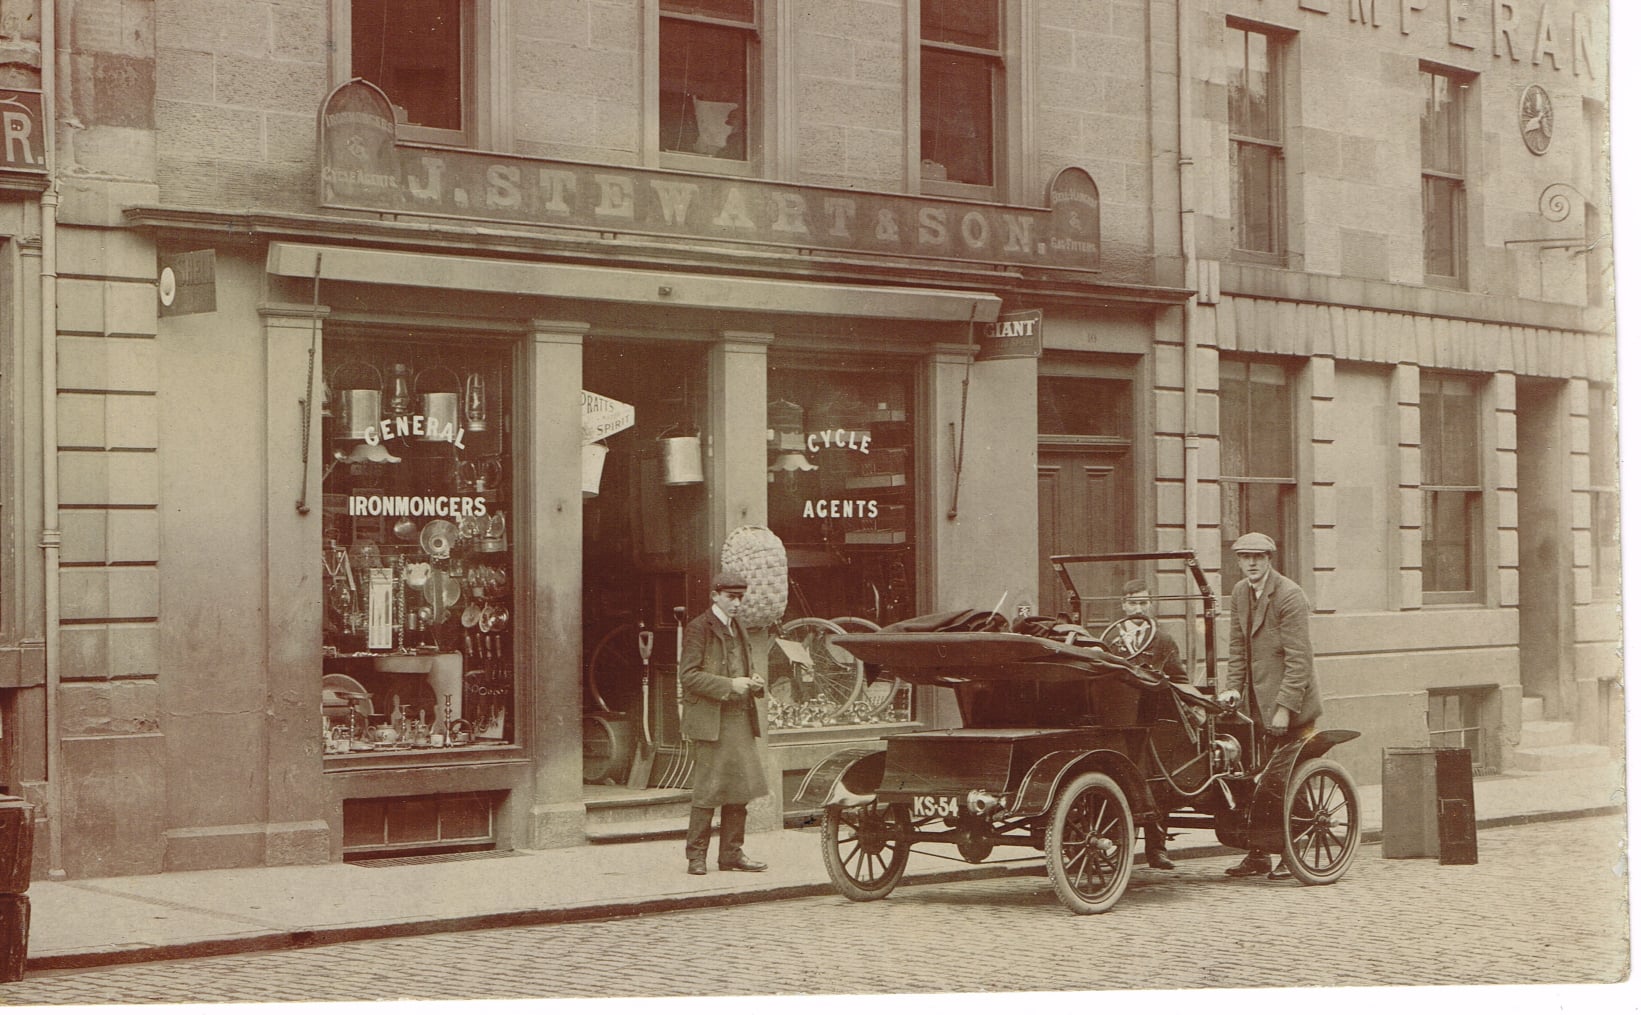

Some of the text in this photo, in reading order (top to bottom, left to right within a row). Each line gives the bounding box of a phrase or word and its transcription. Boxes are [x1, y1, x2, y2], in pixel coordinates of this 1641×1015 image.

[486, 164, 858, 238] STEWART
[875, 208, 899, 241] &
[918, 206, 1046, 255] SON.
[1068, 210, 1083, 232] &
[983, 319, 1036, 338] GIANT
[364, 415, 466, 450] GENERAL
[597, 414, 631, 436] SPIRIT
[807, 428, 872, 454] CYCLE
[349, 495, 487, 517] IRONMONGERS
[803, 500, 878, 518] AGENTS
